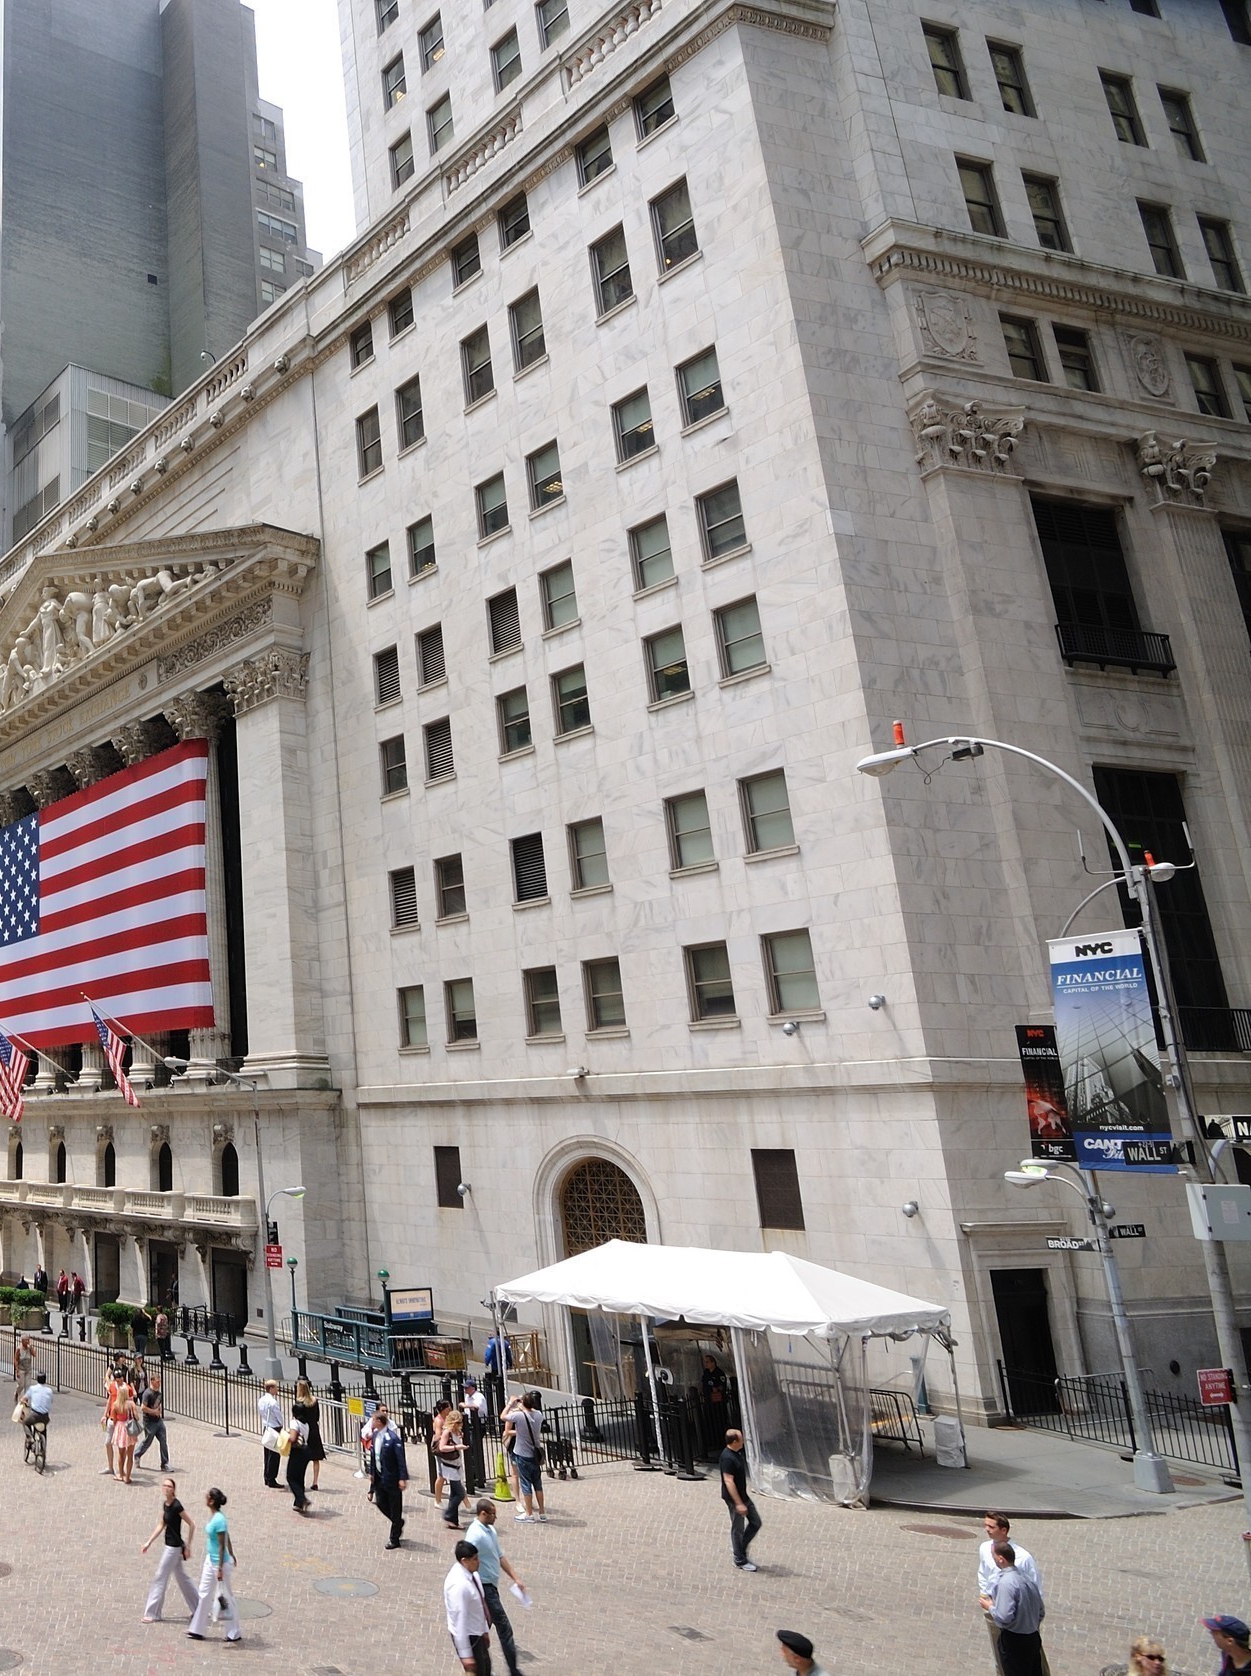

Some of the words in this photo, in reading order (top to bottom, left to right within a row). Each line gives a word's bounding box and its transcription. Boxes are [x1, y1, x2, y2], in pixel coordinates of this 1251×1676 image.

[1074, 941, 1113, 957] NYC
[1056, 967, 1142, 985] FINANCIAL
[1115, 982, 1138, 990] WORLD
[1027, 1029, 1045, 1037] NYC
[1021, 1047, 1058, 1056] FINANCIAL
[1099, 1124, 1144, 1132] nycvisit.com
[1048, 1143, 1064, 1155] bgc
[1083, 1138, 1139, 1150] CANT
[1127, 1145, 1162, 1161] WALL
[1159, 1147, 1168, 1155] ST
[1119, 1227, 1140, 1236] WALL
[1047, 1239, 1079, 1249] BROAD
[323, 1320, 344, 1333] Subway
[1205, 1382, 1226, 1390] ANYTIME
